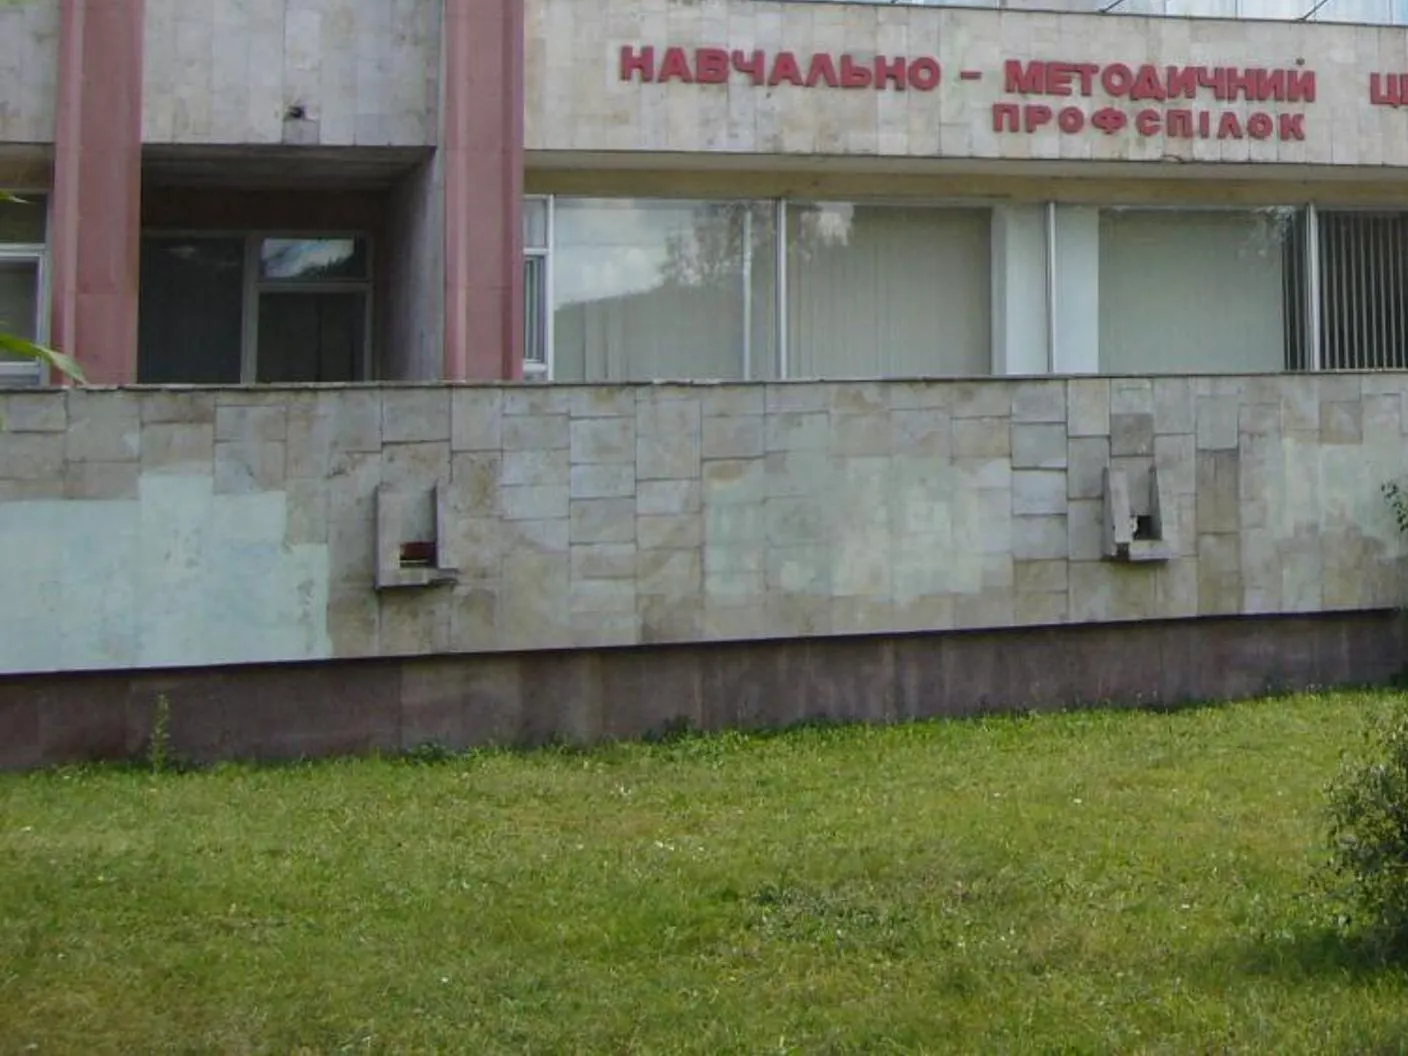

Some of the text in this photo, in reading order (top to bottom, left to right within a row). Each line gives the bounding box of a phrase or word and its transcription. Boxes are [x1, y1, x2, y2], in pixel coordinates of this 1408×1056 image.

[620, 46, 941, 91] НАВЧАЛЬНО
[1005, 58, 1316, 103] МЕТОДИЧНИЙ
[993, 103, 1306, 141] ПРОФСПІЛОК
